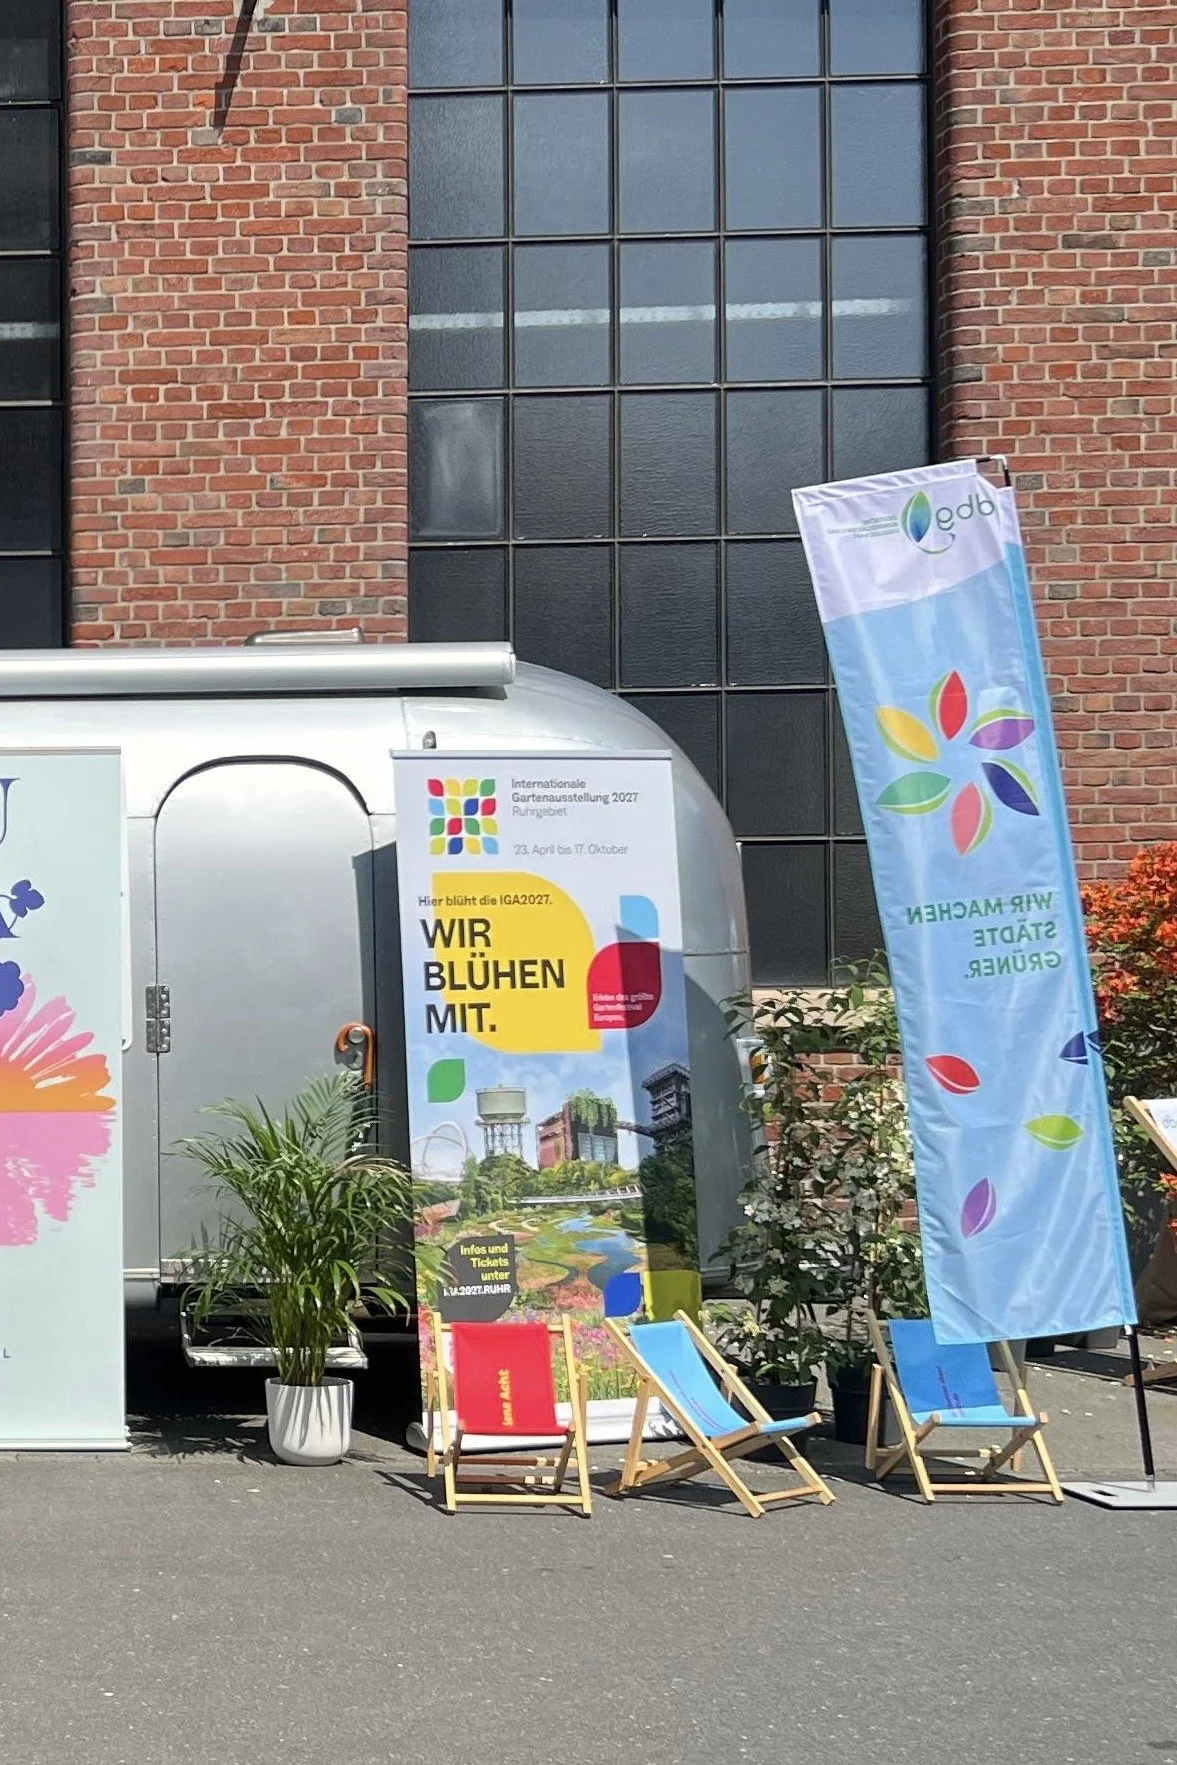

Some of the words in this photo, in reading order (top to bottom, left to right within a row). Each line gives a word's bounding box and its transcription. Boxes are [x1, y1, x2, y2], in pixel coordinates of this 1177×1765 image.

[511, 779, 586, 789] Internationale
[511, 792, 609, 805] Gartenausstellung
[611, 792, 639, 803] 2027
[512, 806, 567, 819] Ruhrgebiet
[532, 844, 555, 857] April
[557, 844, 572, 855] bis
[588, 844, 629, 855] Oktober
[418, 895, 444, 906] Hier
[446, 895, 477, 906] blüht
[479, 895, 497, 906] die
[419, 918, 491, 948] WIR
[424, 952, 565, 991] BLÜHEN
[425, 1002, 497, 1033] MIT.
[460, 1244, 487, 1255] Infos
[487, 1242, 509, 1254] und
[470, 1256, 510, 1268] Tickets
[480, 1270, 510, 1281] unter
